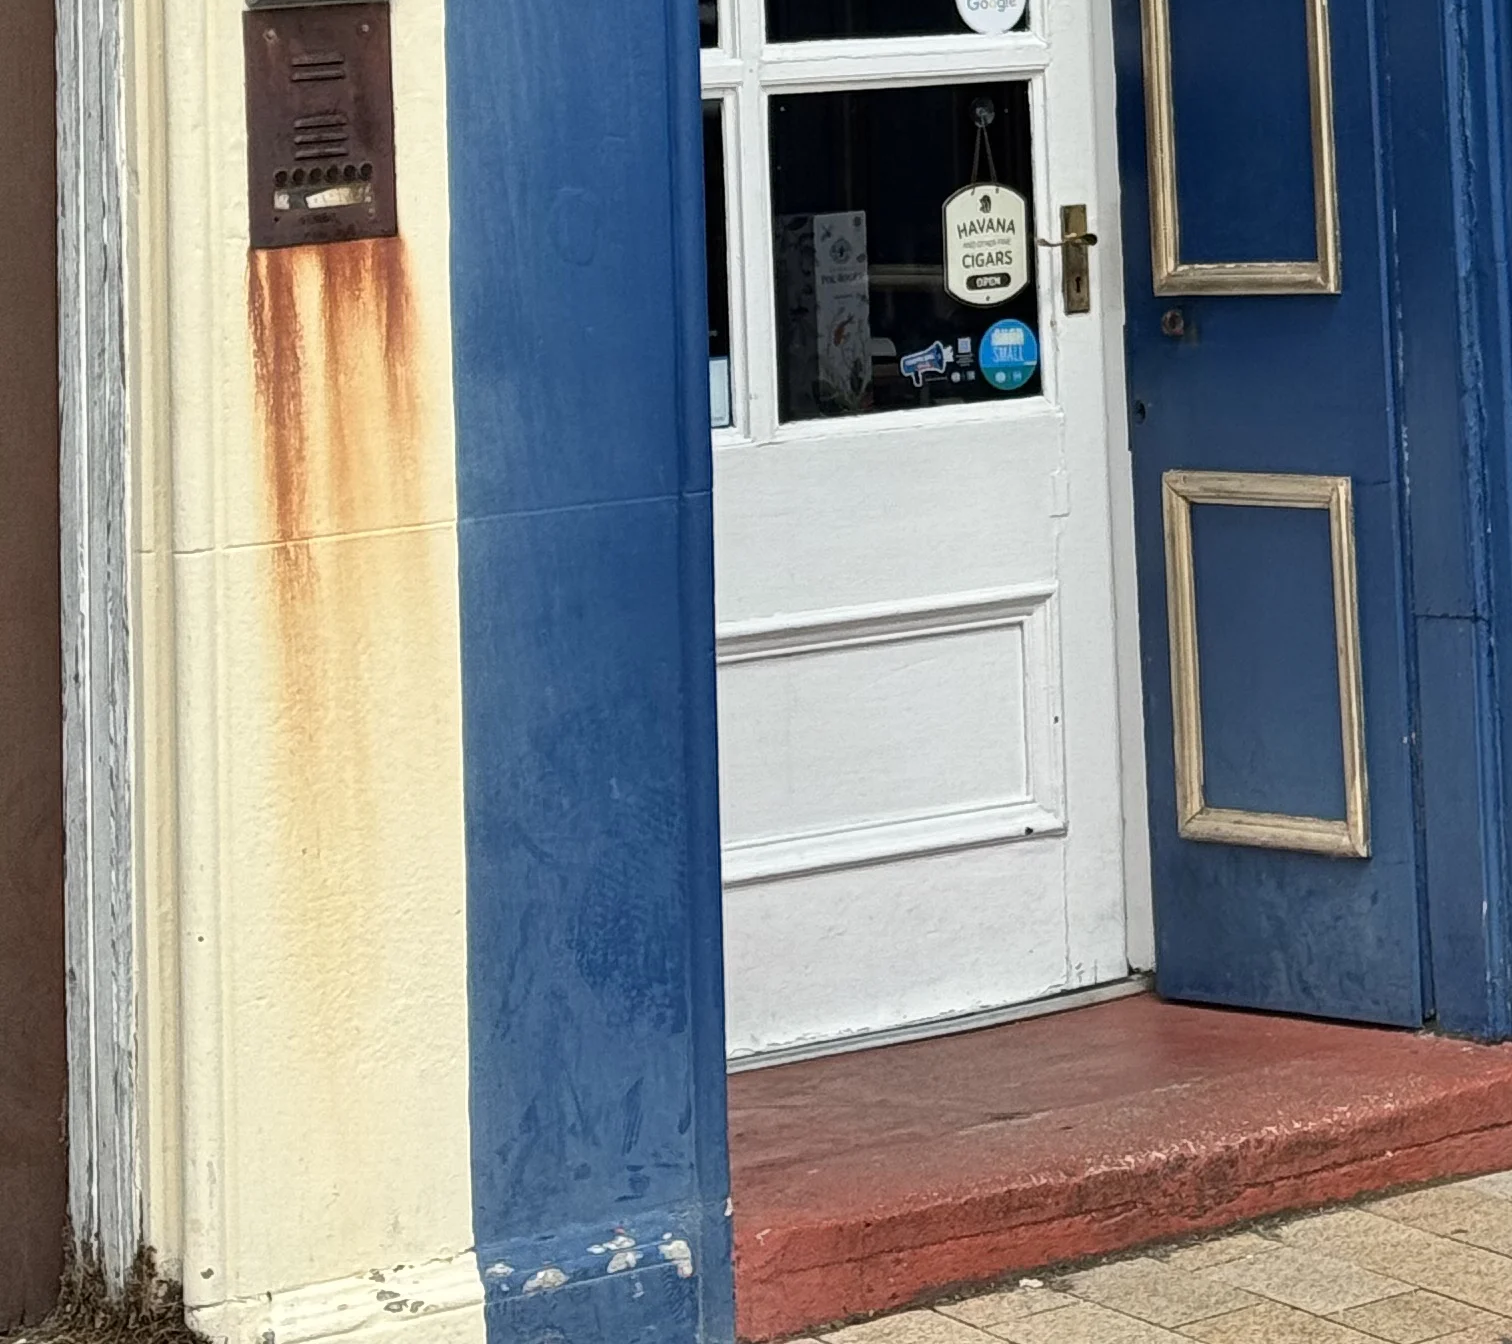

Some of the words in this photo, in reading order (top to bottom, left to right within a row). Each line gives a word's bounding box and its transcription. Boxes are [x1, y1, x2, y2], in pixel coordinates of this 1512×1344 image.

[957, 217, 1016, 239] HAVANA
[962, 250, 1013, 269] CIGARS
[975, 276, 1001, 288] OPEN
